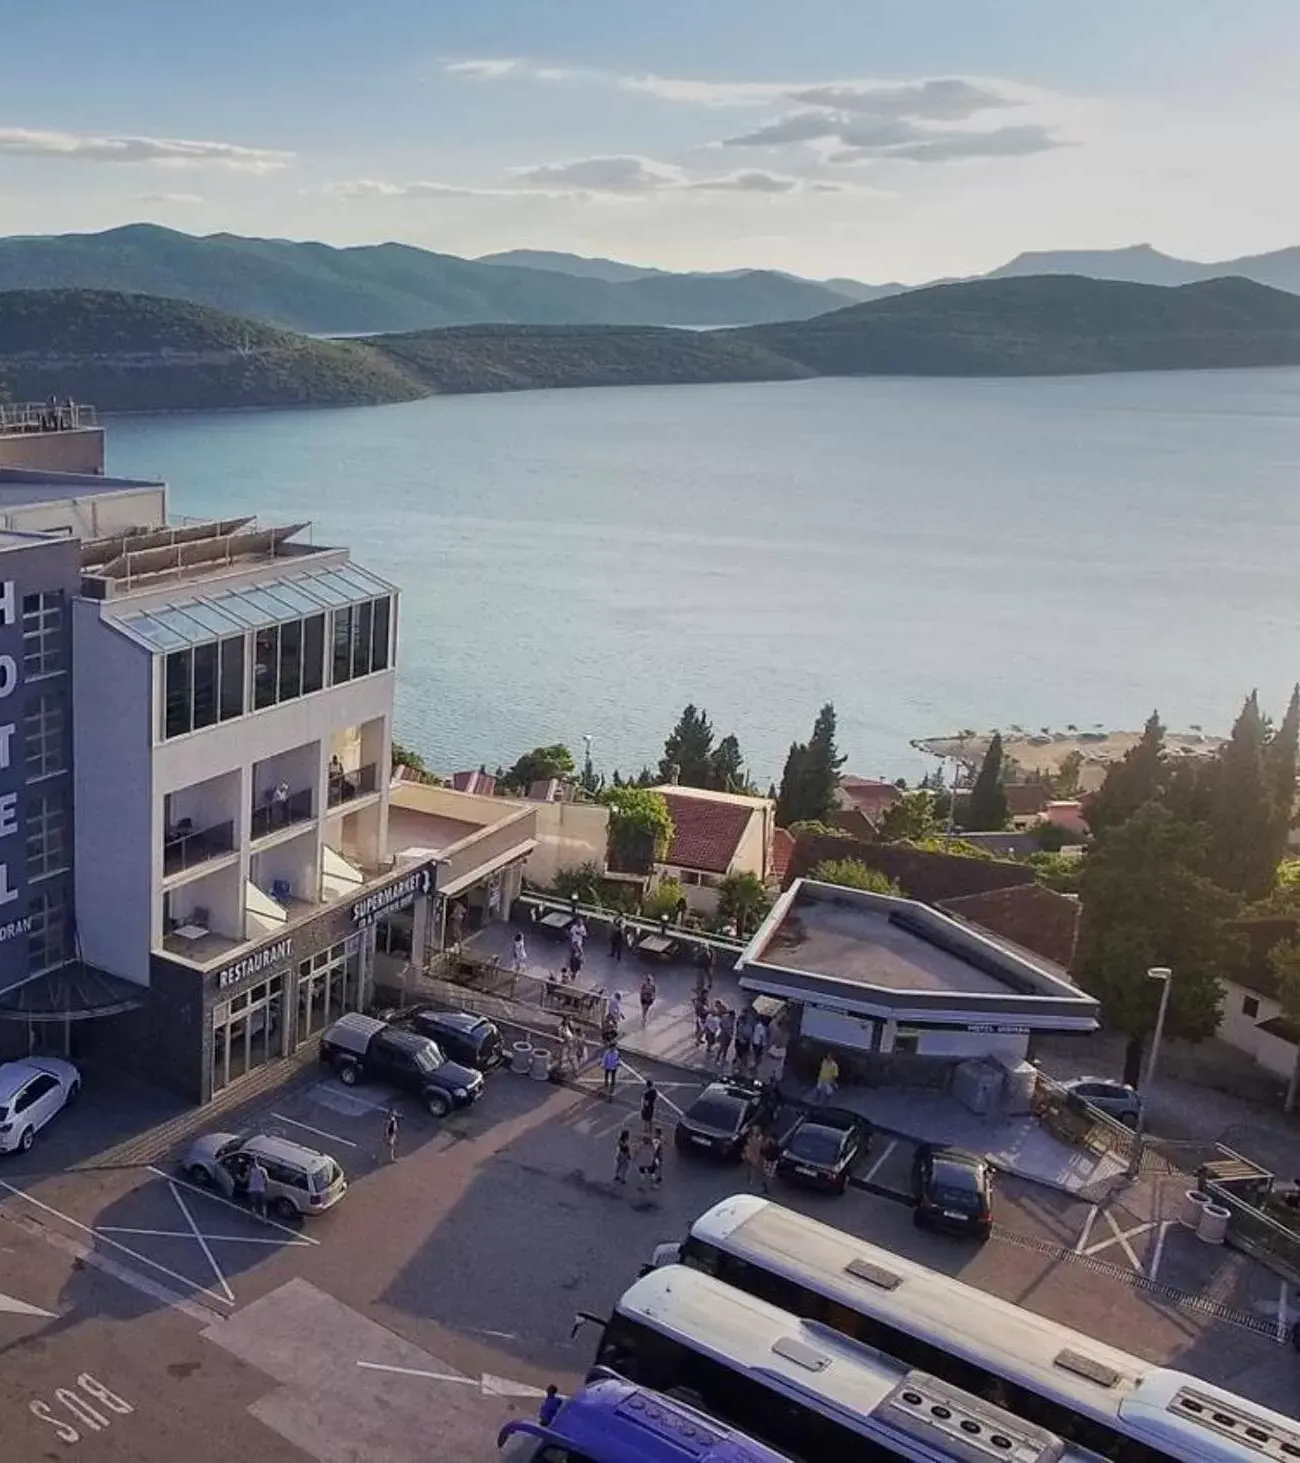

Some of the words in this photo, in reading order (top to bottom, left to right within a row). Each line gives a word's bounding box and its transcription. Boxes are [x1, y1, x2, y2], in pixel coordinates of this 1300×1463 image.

[353, 873, 421, 921] SUPERMARKET
[219, 938, 292, 989] RESTAURANT
[28, 1372, 135, 1443] BUS
